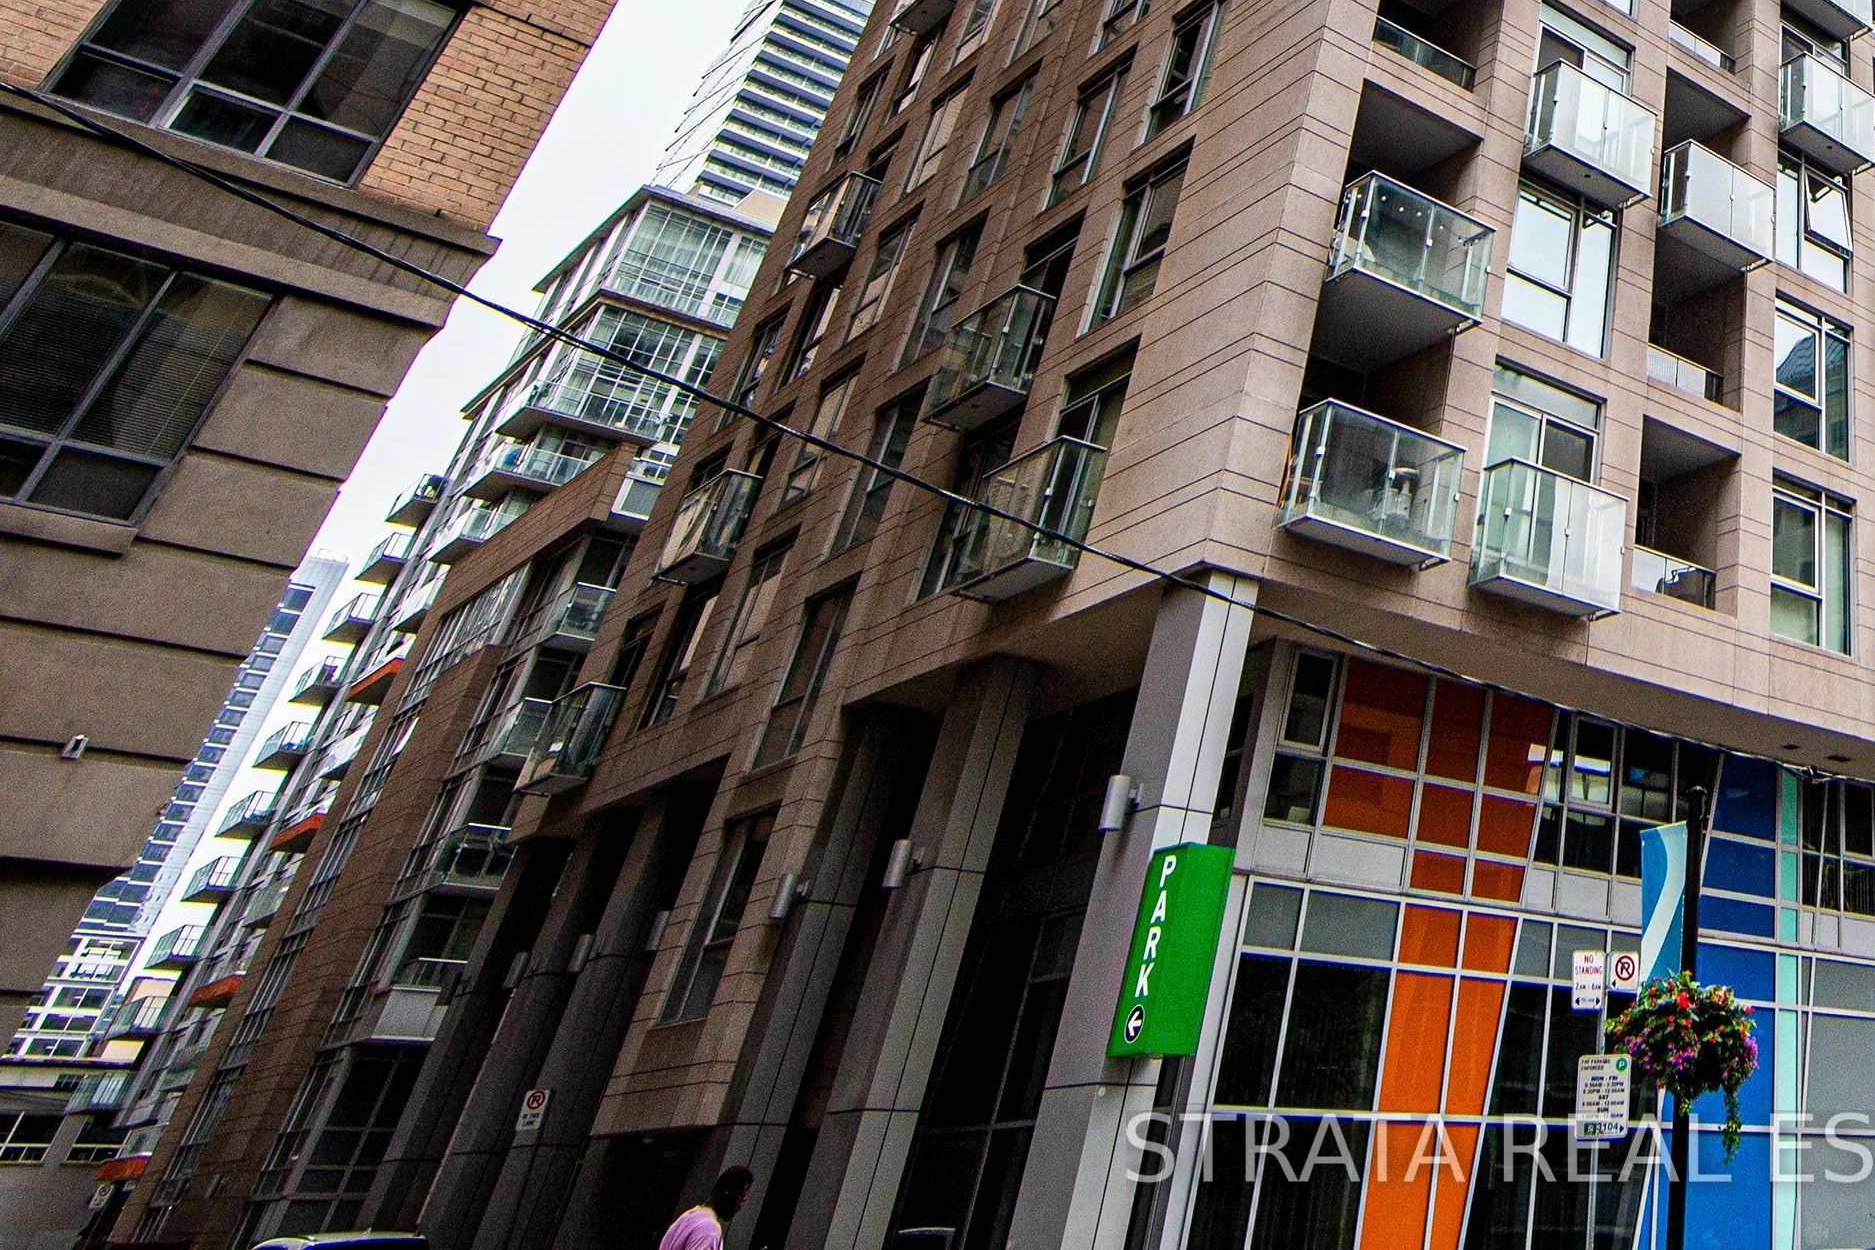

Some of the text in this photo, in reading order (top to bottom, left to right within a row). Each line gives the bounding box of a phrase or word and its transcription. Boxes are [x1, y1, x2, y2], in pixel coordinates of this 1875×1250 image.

[1134, 854, 1177, 998] PARK
[1583, 954, 1594, 964] NO
[1575, 965, 1603, 975] STANDING
[1596, 1122, 1618, 1131] 3104
